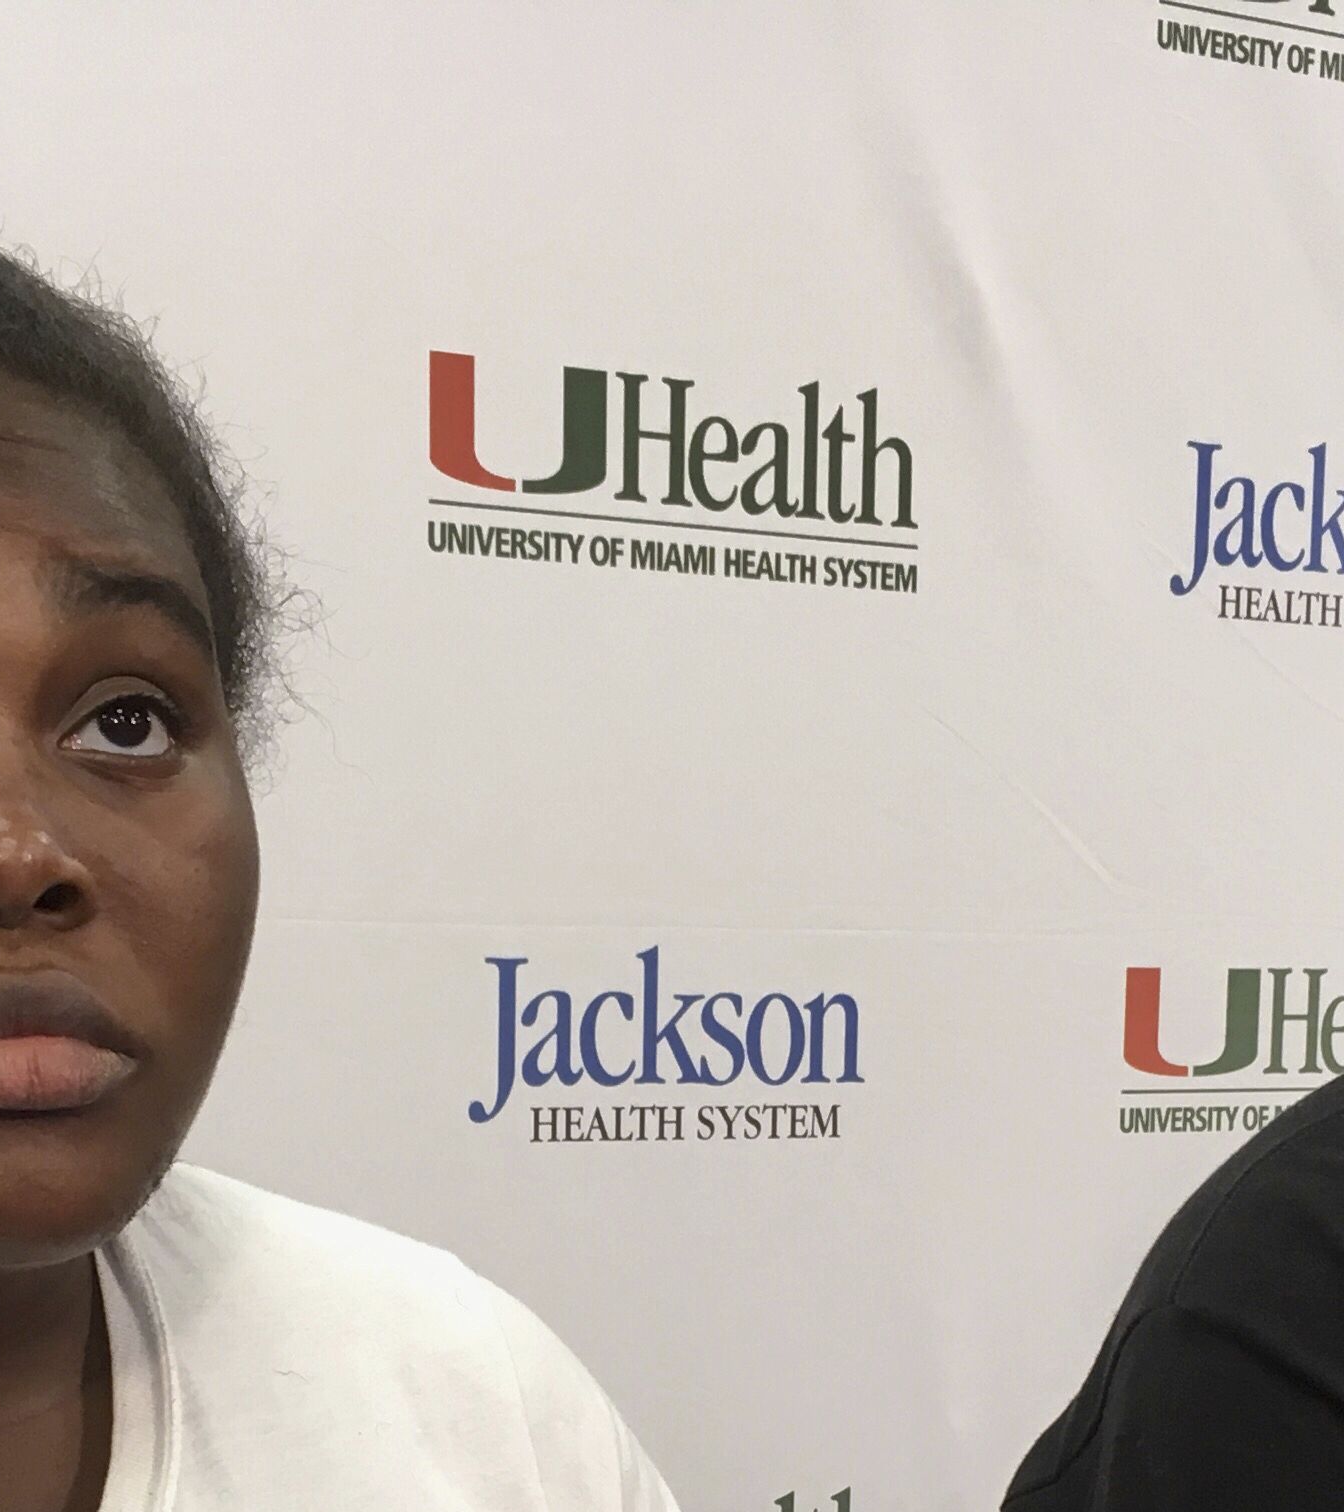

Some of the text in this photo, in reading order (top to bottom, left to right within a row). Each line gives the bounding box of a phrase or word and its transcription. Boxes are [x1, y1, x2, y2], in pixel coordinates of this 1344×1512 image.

[1157, 19, 1283, 69] UNIVERSITY
[1287, 44, 1315, 75] OF
[429, 350, 919, 529] UHealth
[427, 520, 918, 594] UNIVERSITY OF MIAMI HEALTH SYSTEM
[1217, 584, 1344, 628] HEALTH
[468, 945, 865, 1124] Jackson
[530, 1103, 841, 1143] HEALTH SYSTEM
[1119, 1105, 1239, 1134] UNIVERSITY
[1242, 1105, 1270, 1132] OF
